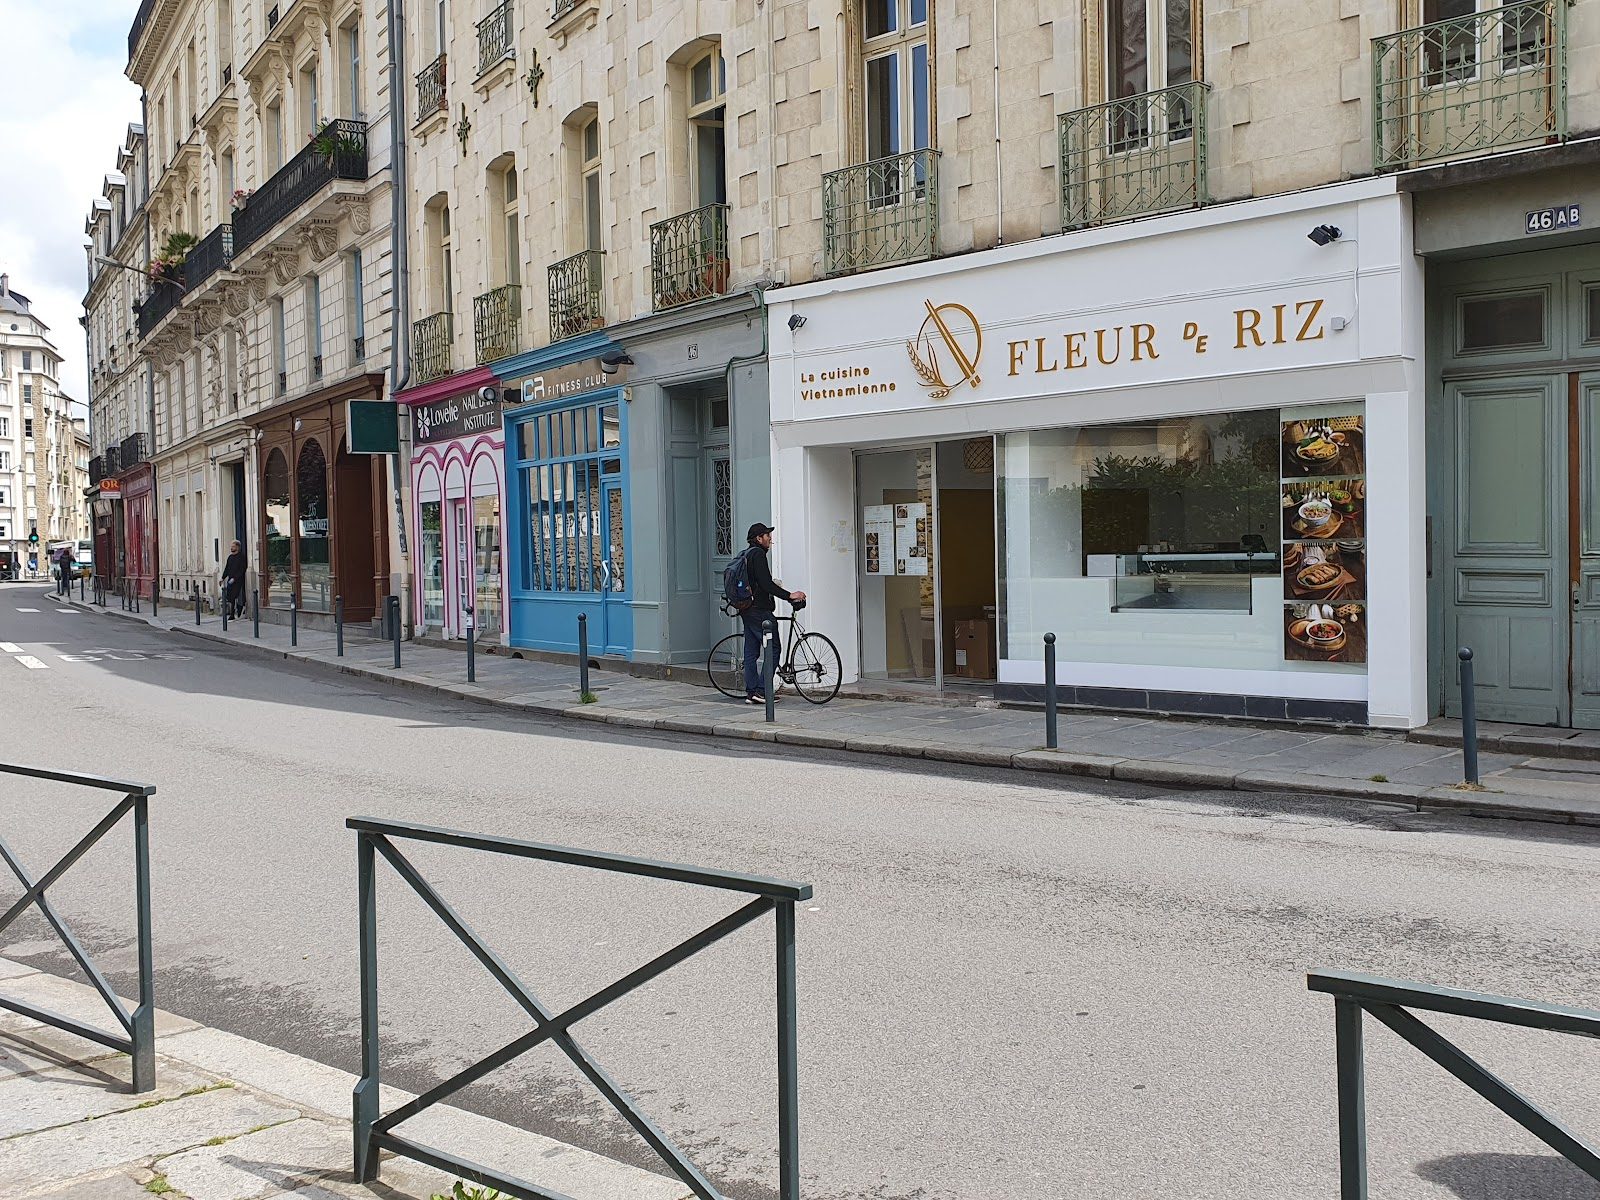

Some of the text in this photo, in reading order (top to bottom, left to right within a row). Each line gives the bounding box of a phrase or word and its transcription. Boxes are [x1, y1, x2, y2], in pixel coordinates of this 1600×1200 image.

[1529, 212, 1552, 229] 46
[1007, 298, 1325, 377] FLEUR DE RIZ
[548, 379, 581, 396] FITNESS
[585, 372, 607, 388] CLUB
[800, 365, 871, 384] La cuisine
[800, 381, 897, 401] Vietnamienne
[430, 400, 459, 427] Lovelie
[464, 411, 495, 431] INSTITUTE
